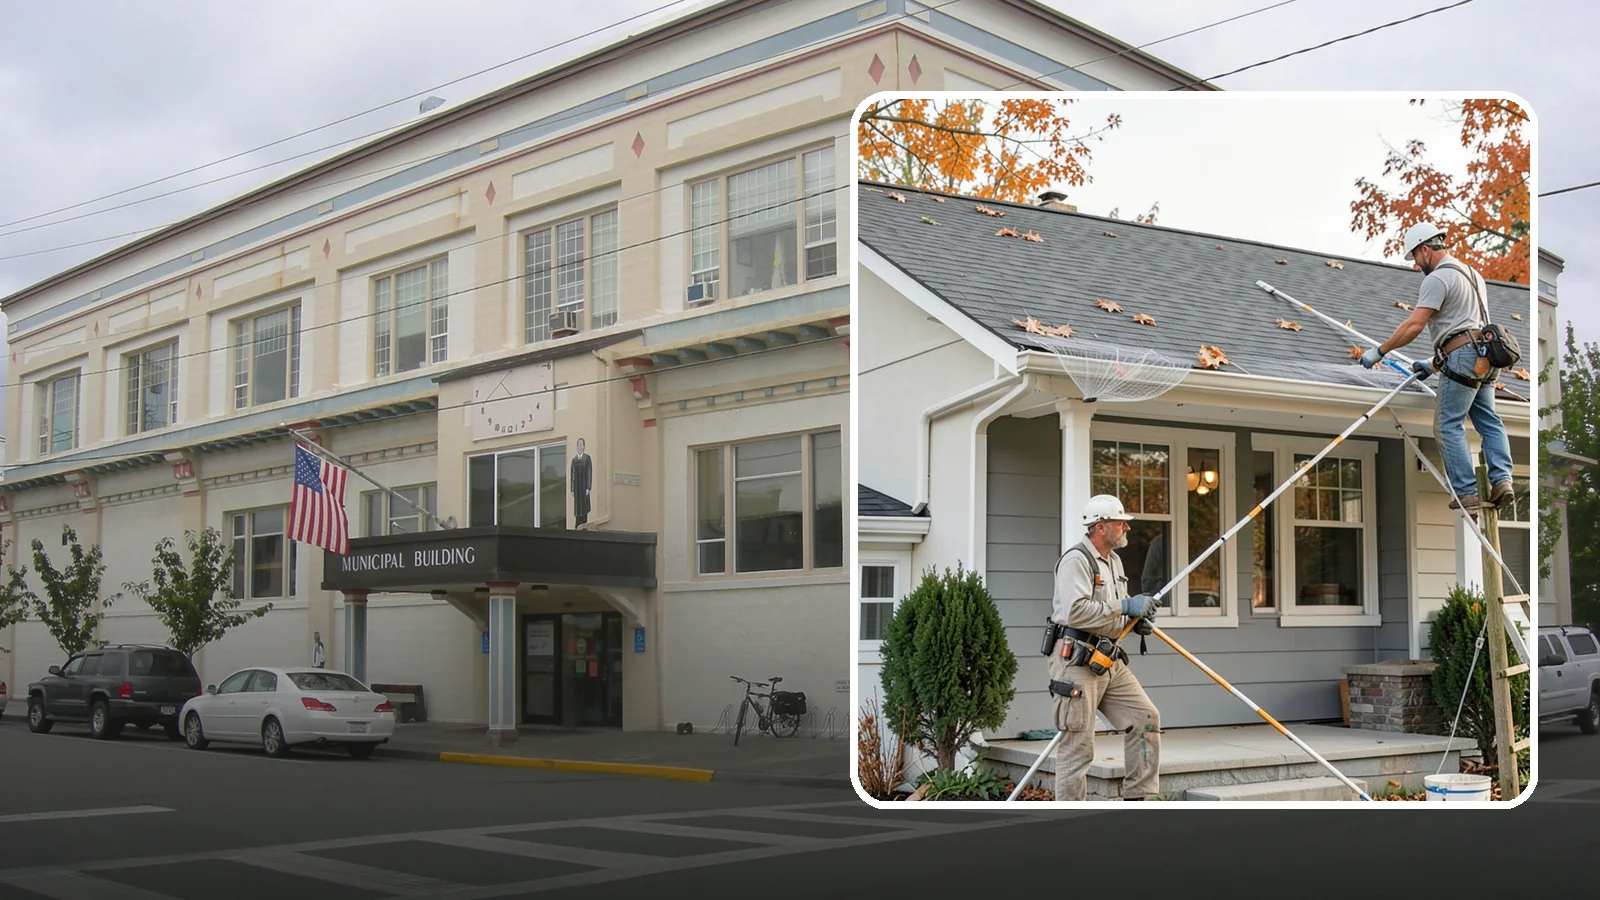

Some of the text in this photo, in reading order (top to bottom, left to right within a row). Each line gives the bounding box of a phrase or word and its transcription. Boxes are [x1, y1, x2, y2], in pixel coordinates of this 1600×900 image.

[481, 407, 484, 415] 8
[488, 418, 492, 426] 9
[495, 424, 500, 432] 10
[507, 425, 513, 433] 12
[521, 420, 525, 428] 2
[529, 414, 533, 422] 3
[536, 402, 540, 410] 4
[342, 546, 475, 571] MUNICIPAL BUILDING
